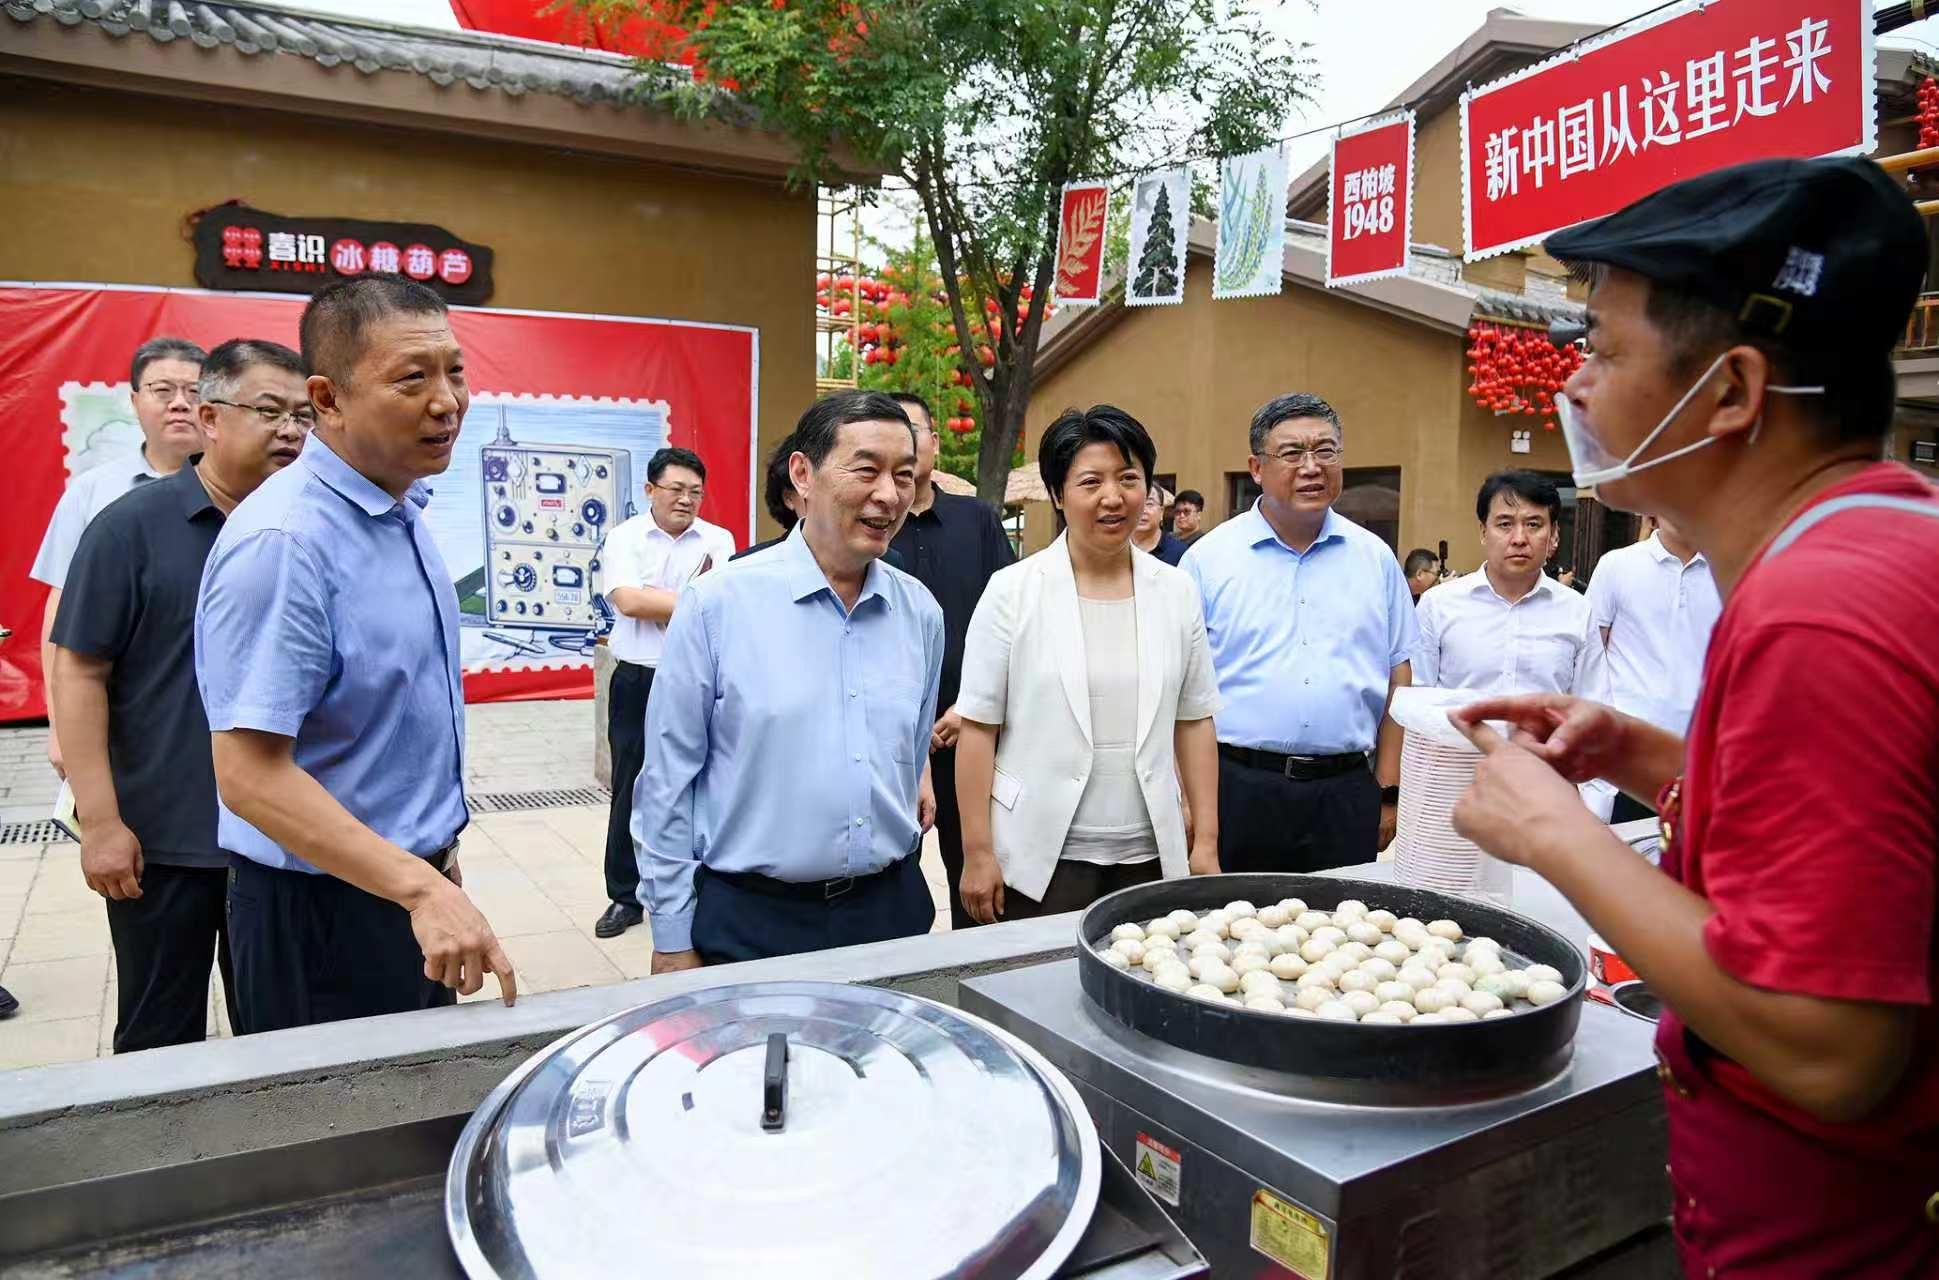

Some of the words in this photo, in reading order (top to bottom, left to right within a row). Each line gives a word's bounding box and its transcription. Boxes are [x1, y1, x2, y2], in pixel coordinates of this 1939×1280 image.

[1484, 17, 1832, 201] 新中国从这里走来
[1344, 163, 1396, 204] 西柏坡
[1343, 196, 1394, 240] 1948
[268, 232, 326, 264] 喜识
[335, 243, 468, 280] 冰糖葫芦
